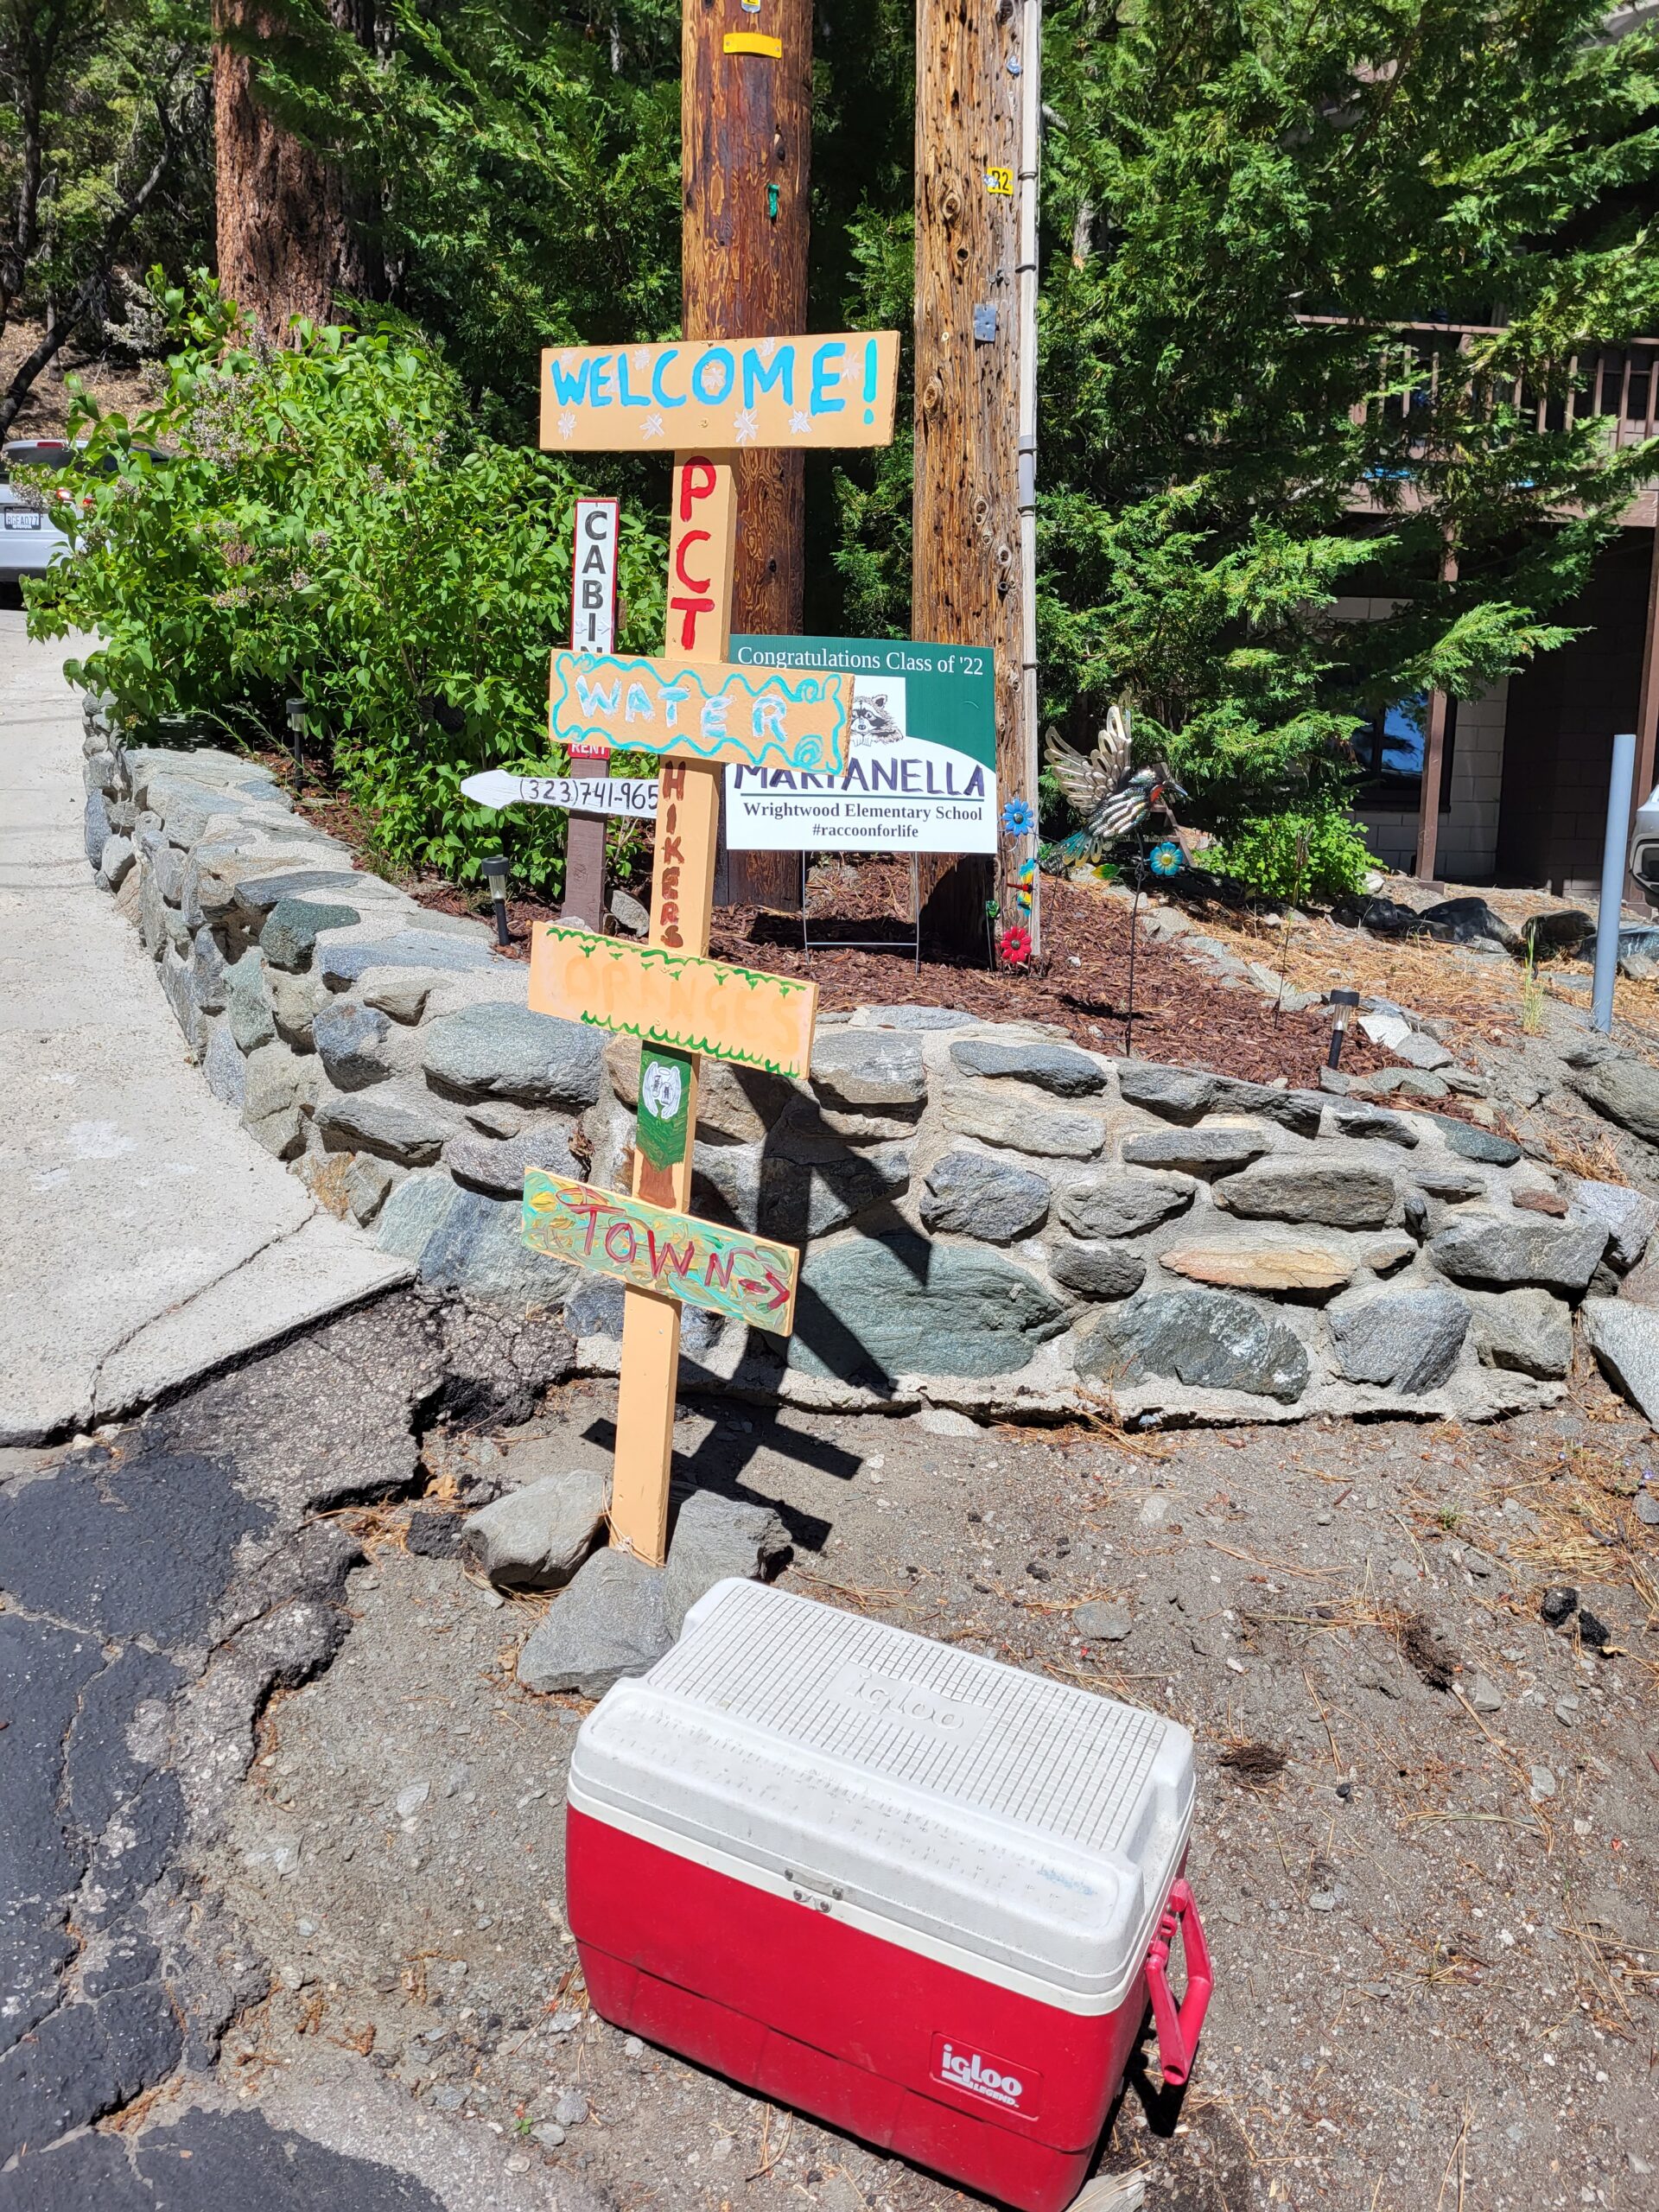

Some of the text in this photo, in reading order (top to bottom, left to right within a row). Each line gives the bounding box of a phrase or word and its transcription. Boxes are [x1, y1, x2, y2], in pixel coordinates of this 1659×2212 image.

[551, 338, 878, 424] WELCOME!
[582, 511, 607, 653] CABI
[671, 455, 716, 651] PCT
[737, 646, 984, 676] Congratulations Class of '22
[575, 676, 788, 741] WATER
[743, 802, 983, 822] Wrightwood Elementary School
[811, 823, 919, 838] #raccoonforlife
[660, 760, 686, 949] HIKERS
[564, 956, 801, 1055] ORANGES
[556, 1187, 735, 1289] TOWN
[846, 1672, 965, 1730] igloo
[942, 2043, 1022, 2096] igloo
[972, 2081, 1016, 2106] LEGEND
